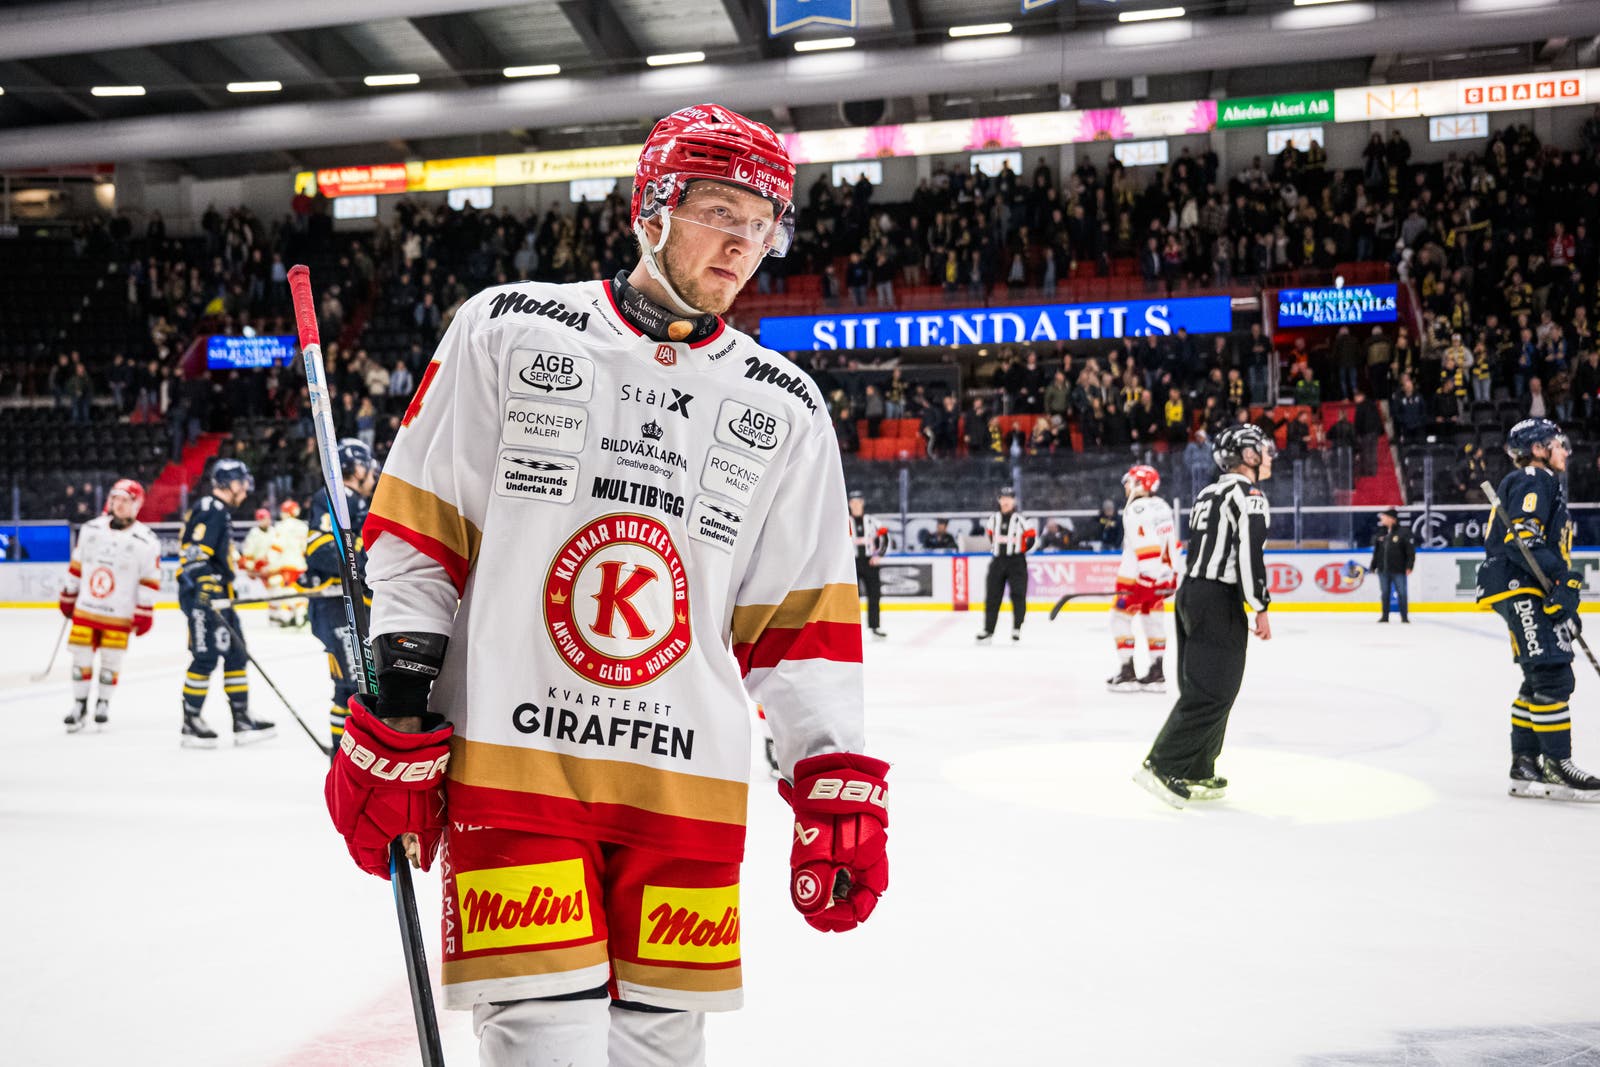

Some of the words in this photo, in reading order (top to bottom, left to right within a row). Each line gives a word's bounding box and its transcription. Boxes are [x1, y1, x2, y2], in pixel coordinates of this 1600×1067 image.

[756, 169, 790, 191] SVENSKA
[489, 291, 590, 332] Molins
[621, 300, 659, 329] Sparbank
[529, 371, 573, 386] SERVICE
[531, 353, 575, 375] AGB
[507, 411, 583, 431] ROCKNEBY
[524, 425, 561, 438] MÅLERI
[736, 423, 772, 446] SERVICE
[739, 408, 777, 437] AGB
[616, 455, 649, 472] Creative
[504, 470, 569, 487] Calmarsunds
[505, 482, 548, 495] Undertak
[549, 484, 564, 497] AB
[591, 476, 685, 518] MULTIBYGG
[555, 523, 611, 582] KALMAR
[615, 521, 672, 558] HOCKEY
[668, 556, 686, 601] CLUB
[588, 560, 659, 640] K
[1513, 599, 1544, 657] Dialect
[552, 621, 586, 667] ANSVAR
[598, 664, 632, 682] GLÖD
[645, 637, 687, 675] HJÄRTA
[548, 686, 672, 716] KVARTERET
[512, 702, 694, 760] GIRAFFEN
[443, 841, 456, 955] KALMAR
[463, 885, 584, 934] Molins
